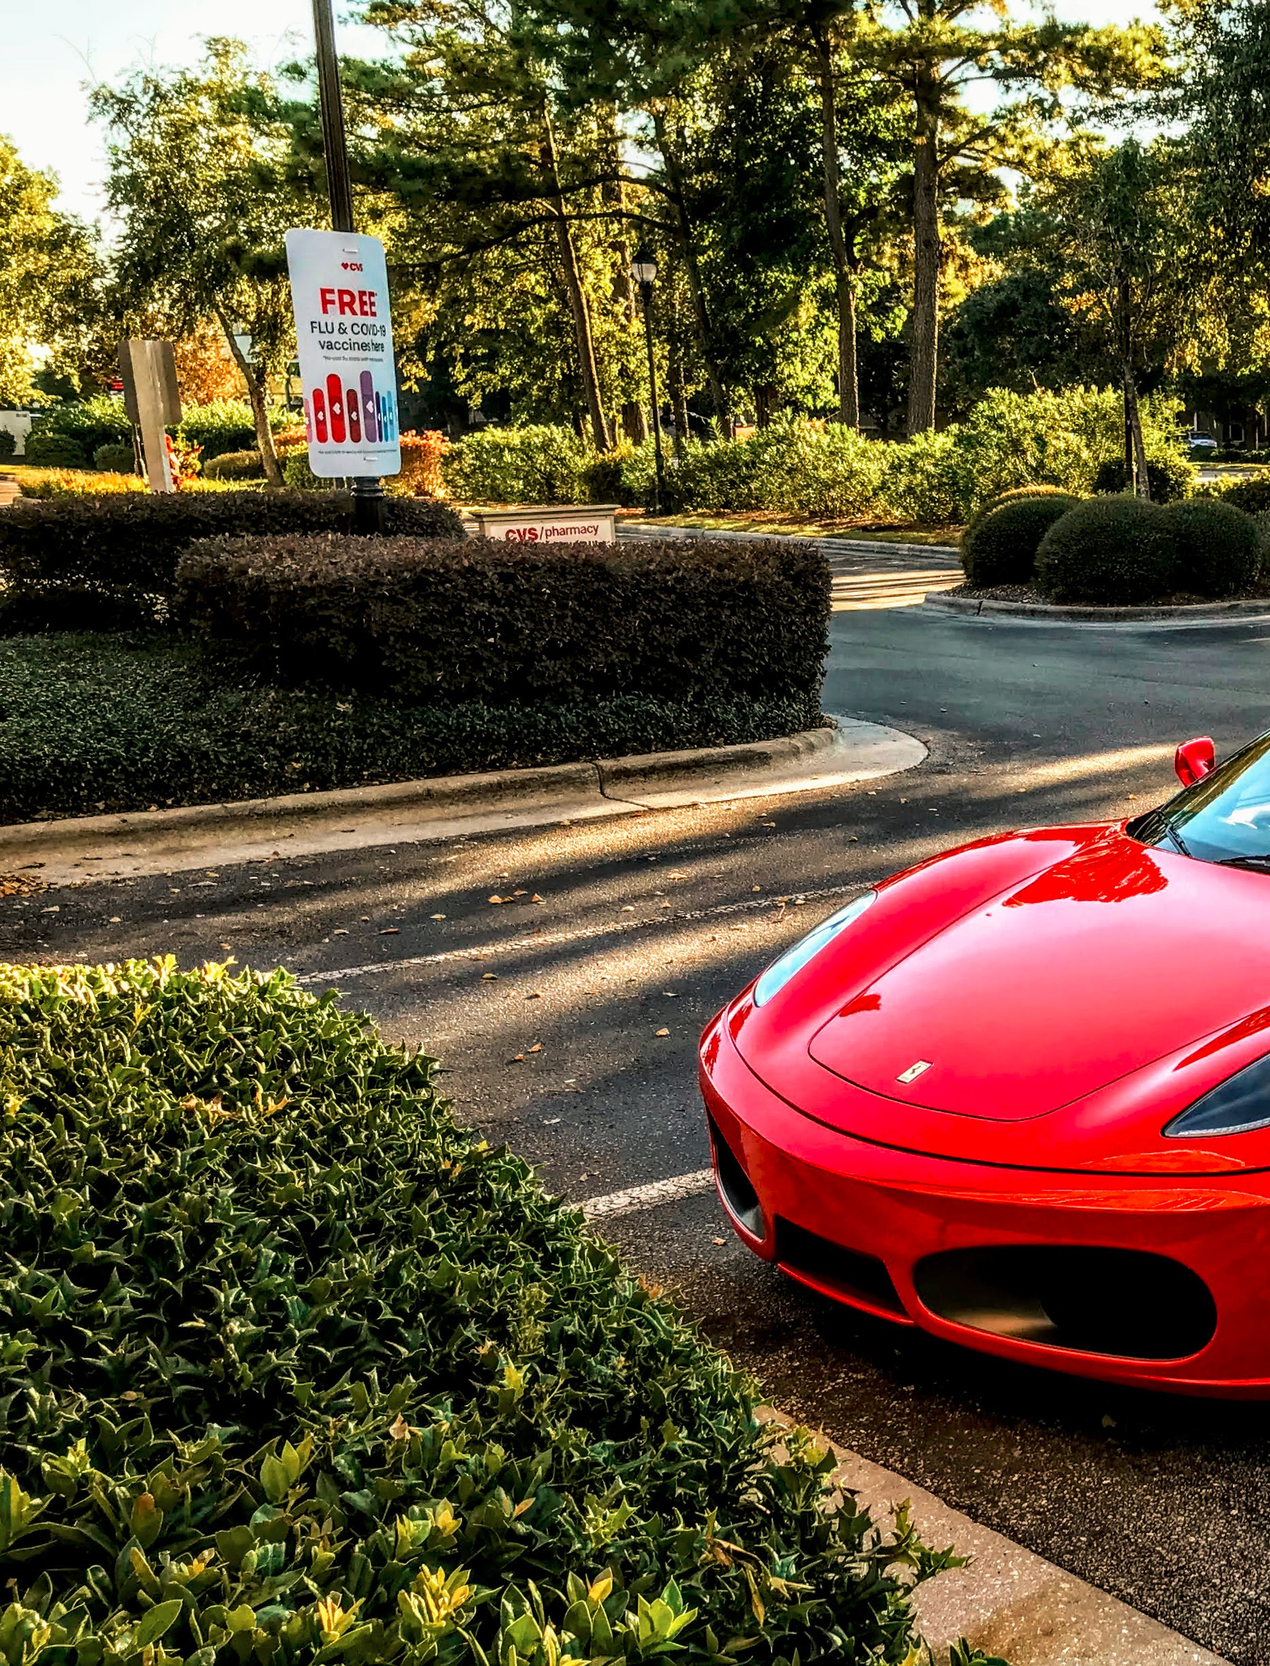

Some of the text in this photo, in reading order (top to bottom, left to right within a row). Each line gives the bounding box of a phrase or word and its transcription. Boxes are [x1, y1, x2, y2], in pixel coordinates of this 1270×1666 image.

[310, 321, 387, 337] FLU & COVID-19
[318, 338, 385, 352] vaccines here
